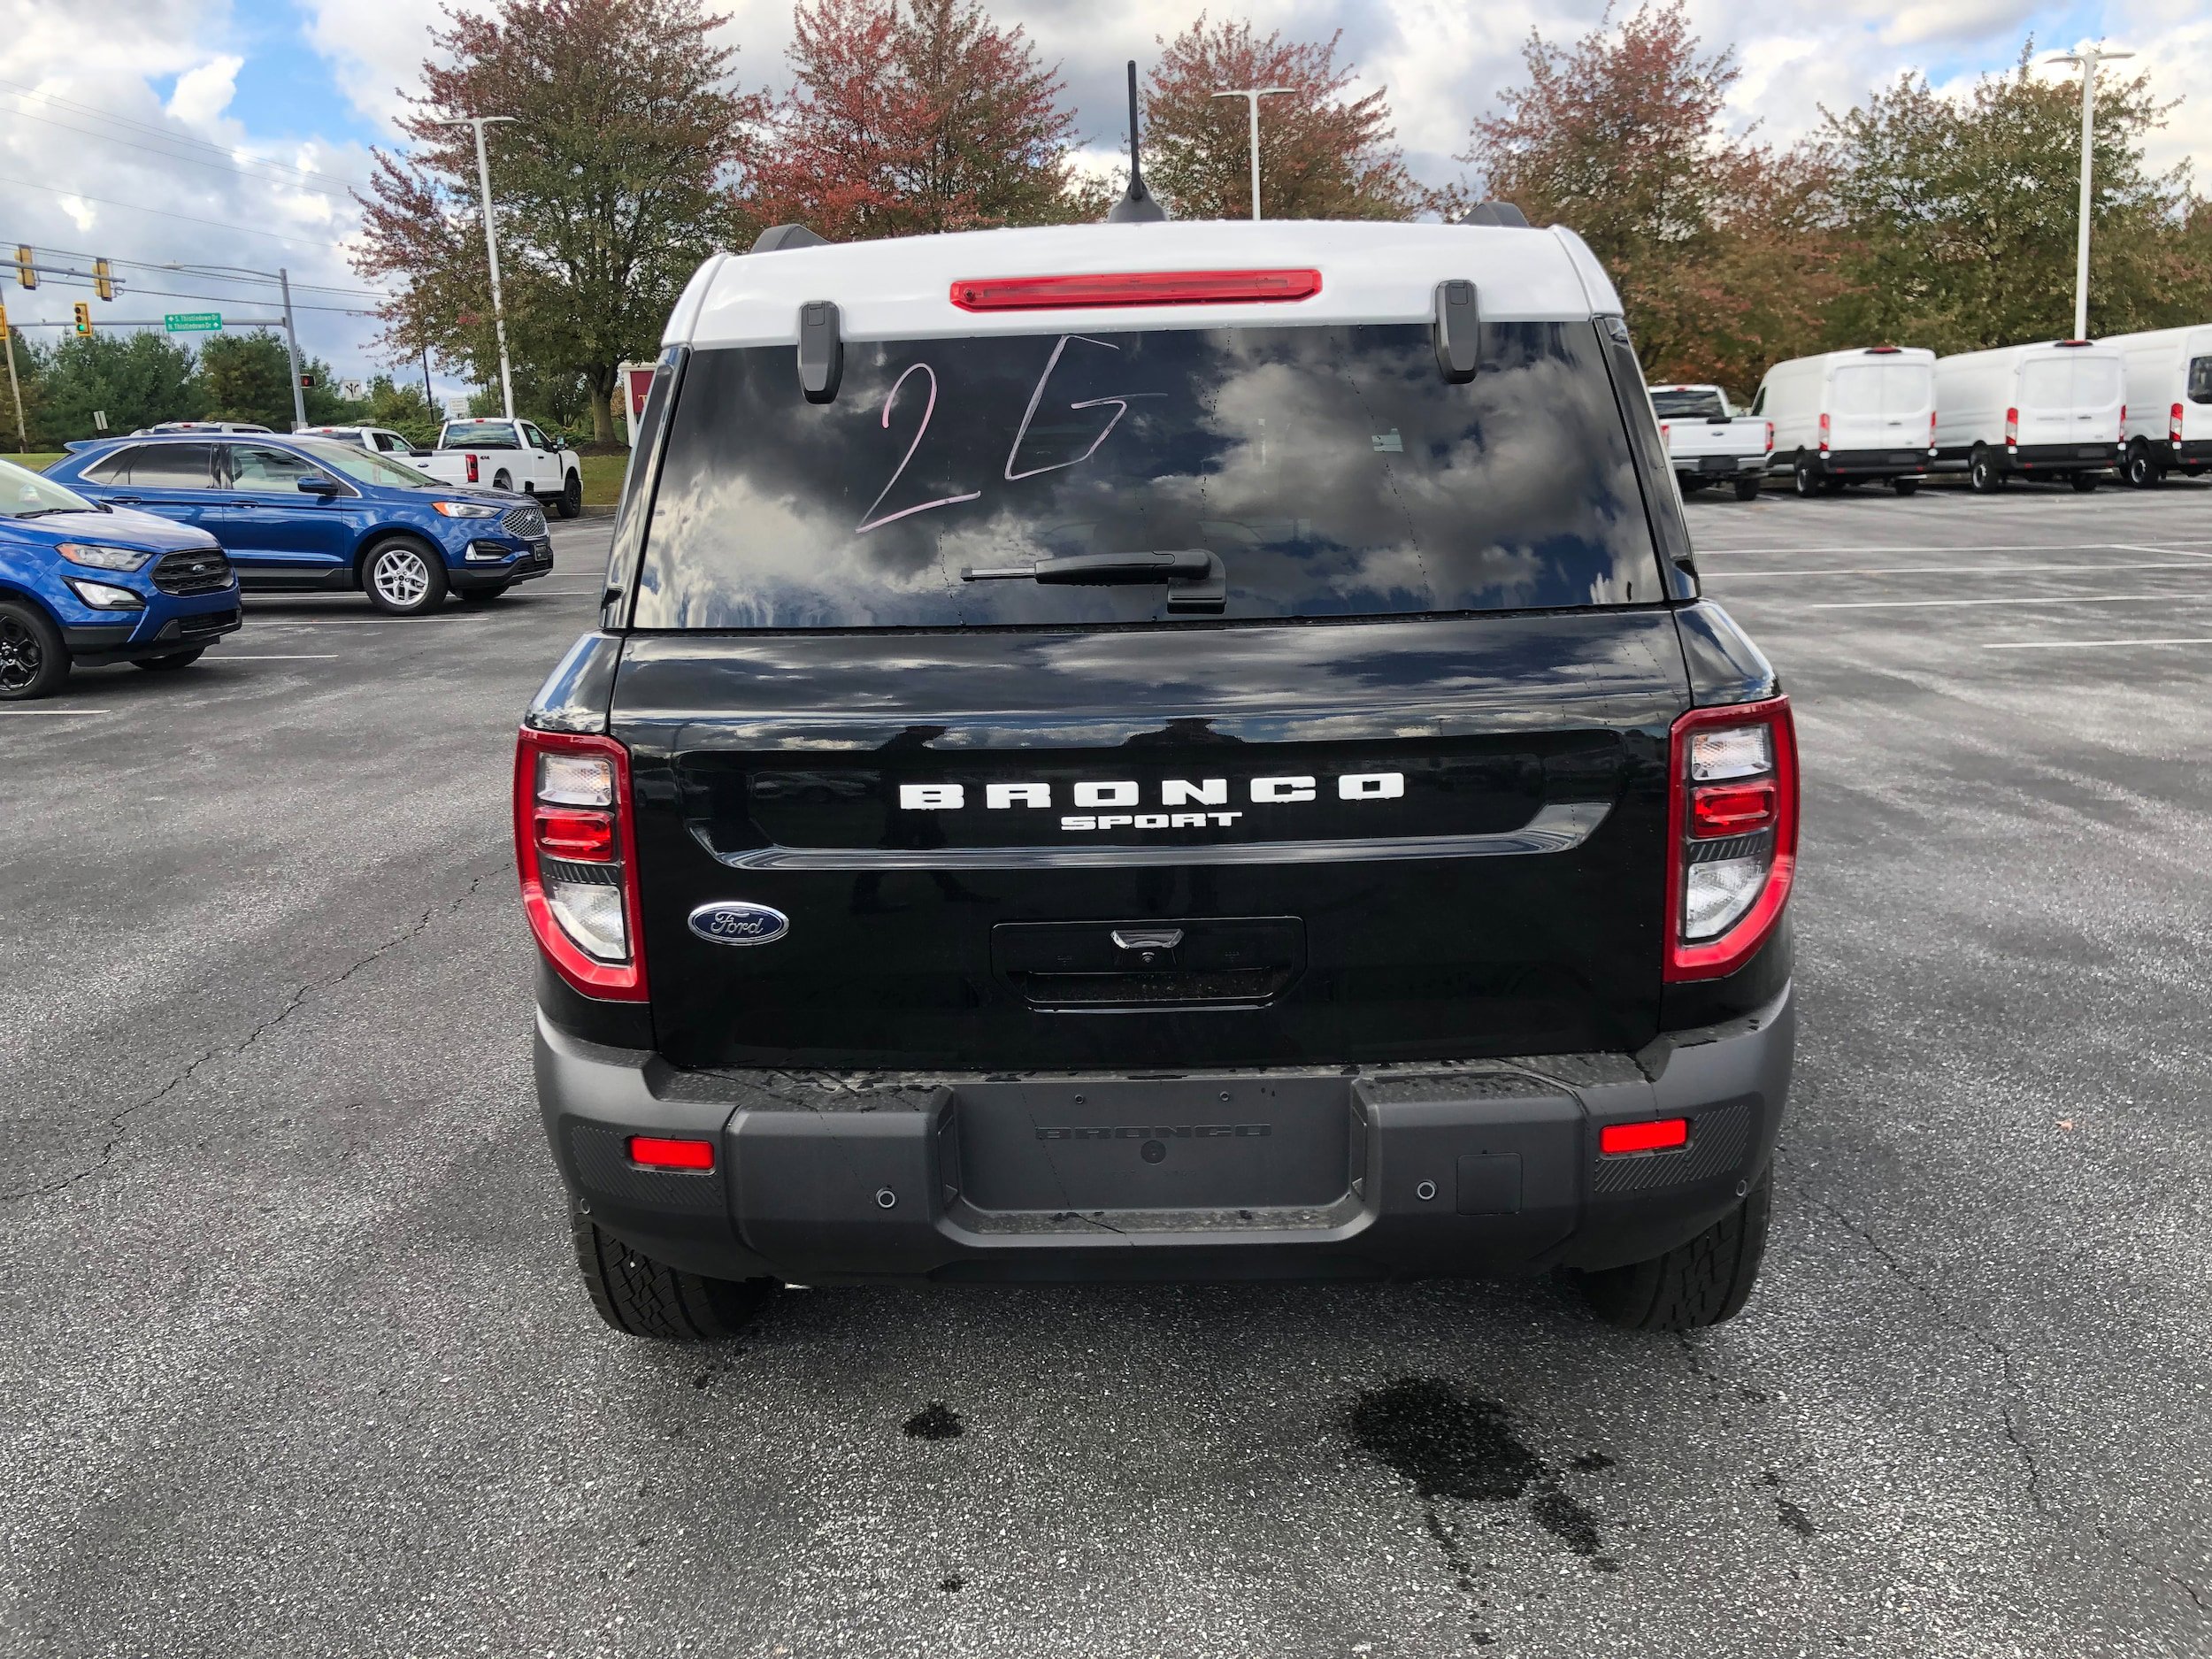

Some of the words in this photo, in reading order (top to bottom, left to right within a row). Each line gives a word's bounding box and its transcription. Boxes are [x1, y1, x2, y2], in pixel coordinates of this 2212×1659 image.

[900, 772, 1404, 810] BRONCO
[1061, 811, 1242, 831] SPORT
[710, 911, 764, 933] Ford
[1035, 1123, 1271, 1140] BRONCO
